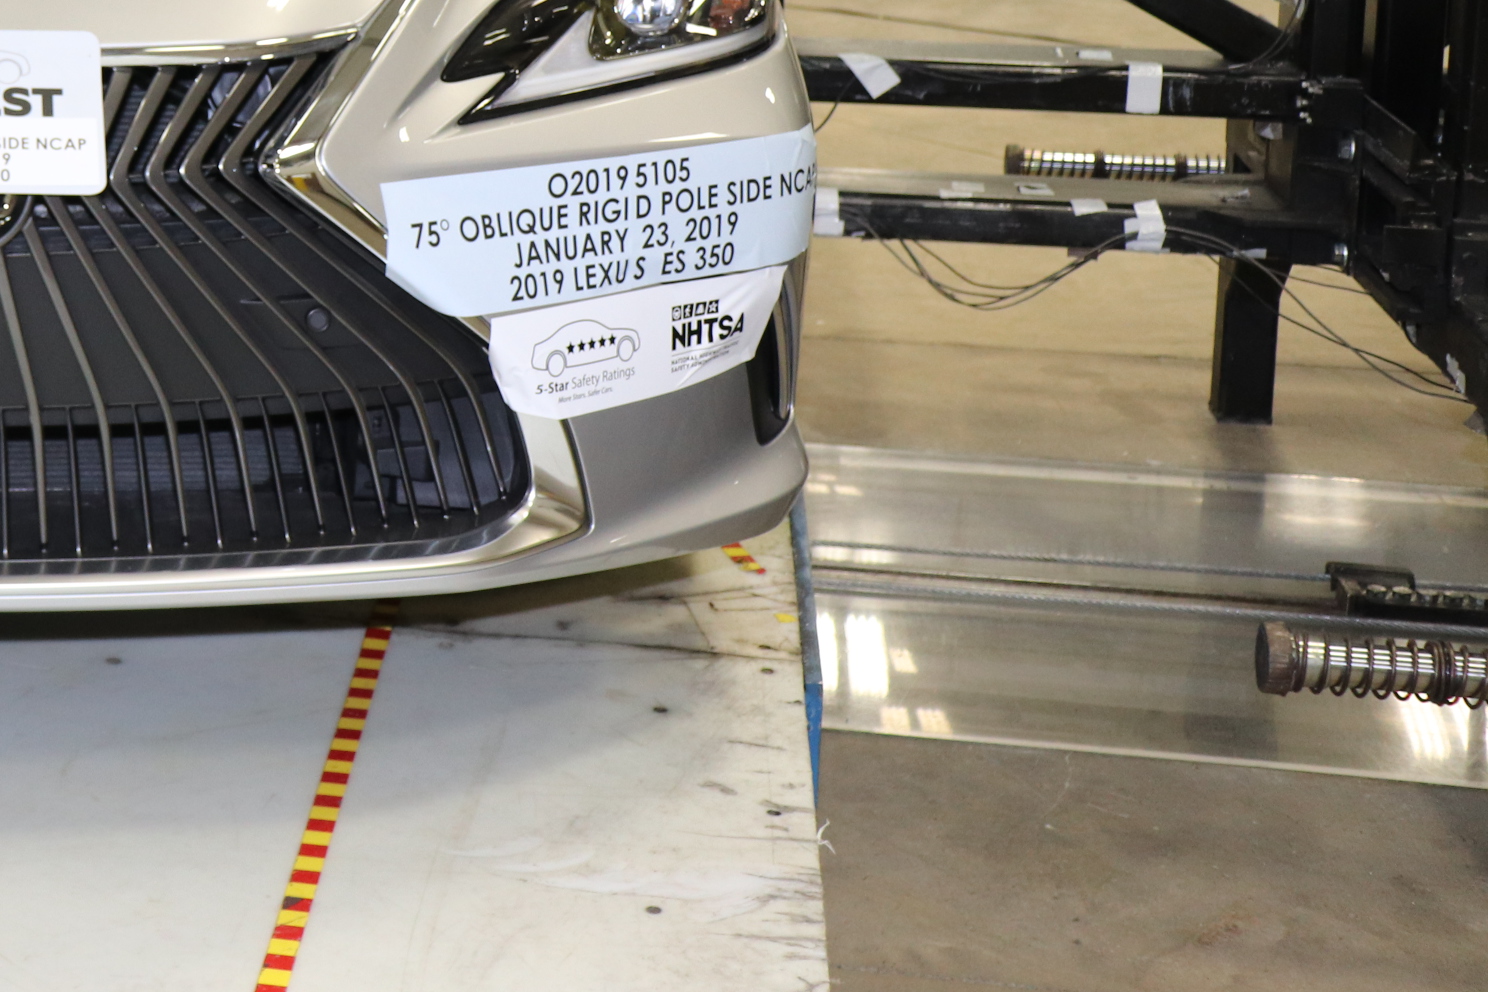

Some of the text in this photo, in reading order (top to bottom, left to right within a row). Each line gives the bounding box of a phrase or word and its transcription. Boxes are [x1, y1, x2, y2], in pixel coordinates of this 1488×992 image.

[36, 137, 87, 151] NCAP
[411, 219, 450, 249] 75°
[459, 204, 569, 243] OBLIQUE
[578, 194, 652, 227] RIGID
[661, 184, 719, 216] POLE
[727, 176, 772, 206] SIDE
[514, 211, 739, 268] JANUARY 23, 2019
[510, 242, 734, 302] 2019 LEXUS ES 350
[671, 312, 744, 351] NHTSA
[535, 367, 635, 395] 5-Star Safety Ratings
